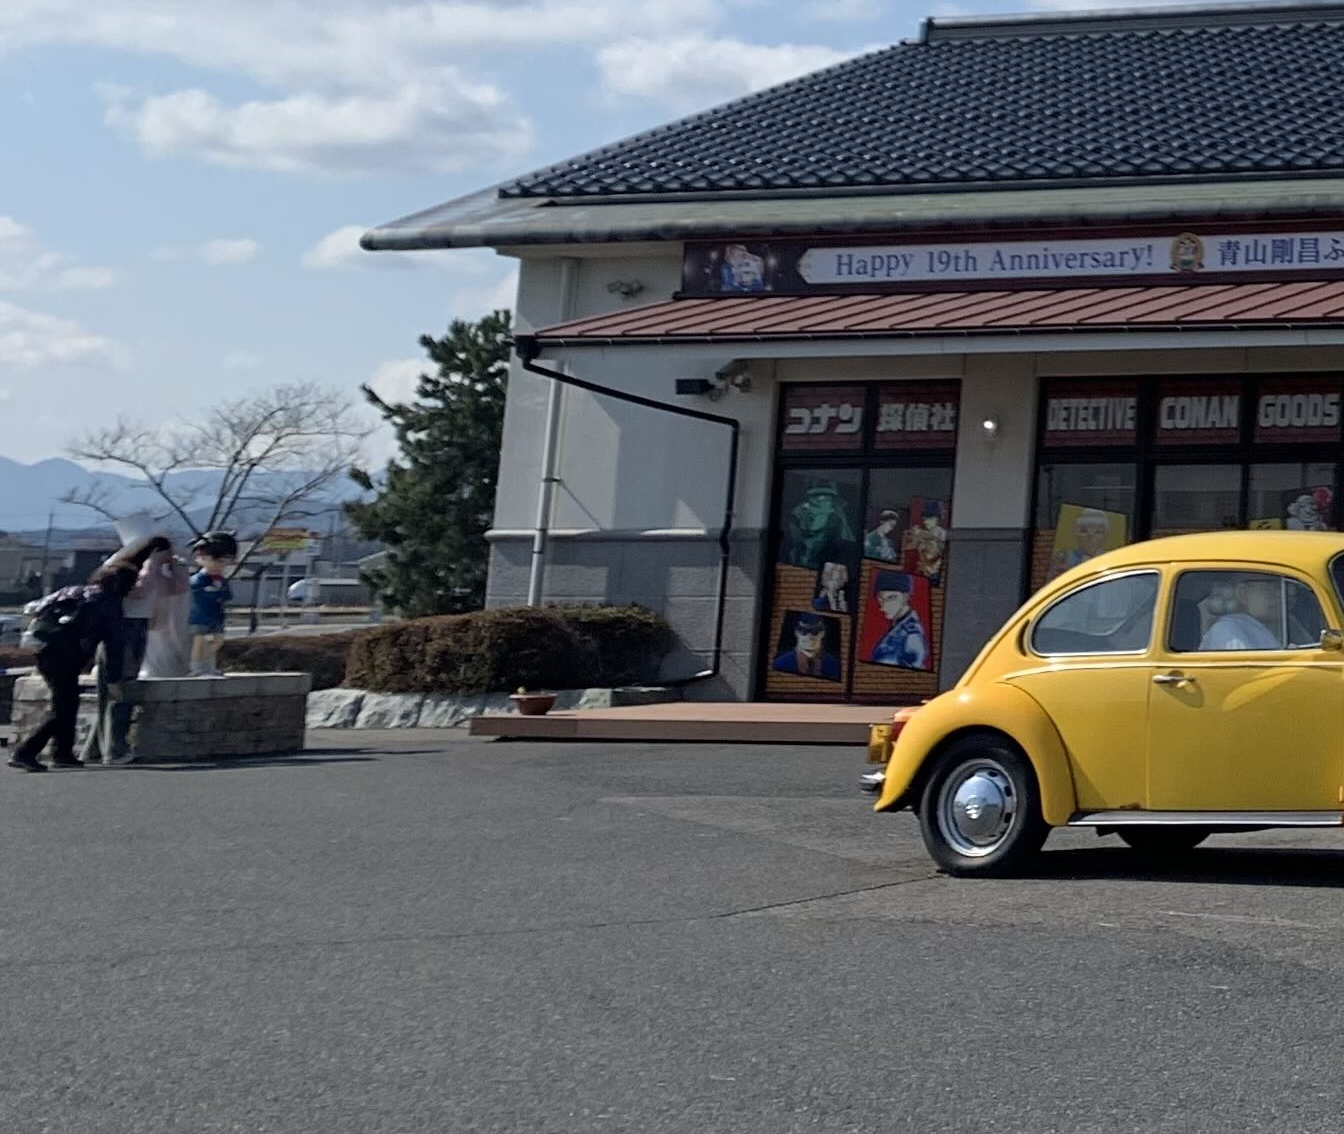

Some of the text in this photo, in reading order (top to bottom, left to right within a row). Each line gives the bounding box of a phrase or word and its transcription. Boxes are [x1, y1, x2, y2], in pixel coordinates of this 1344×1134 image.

[835, 244, 1154, 281] Happy 19th Anniversary!
[784, 402, 956, 434] コナン 探偵社
[1046, 397, 1137, 431] DETECTIVE
[1159, 395, 1240, 429] CONAN
[1257, 394, 1341, 428] GOODS
